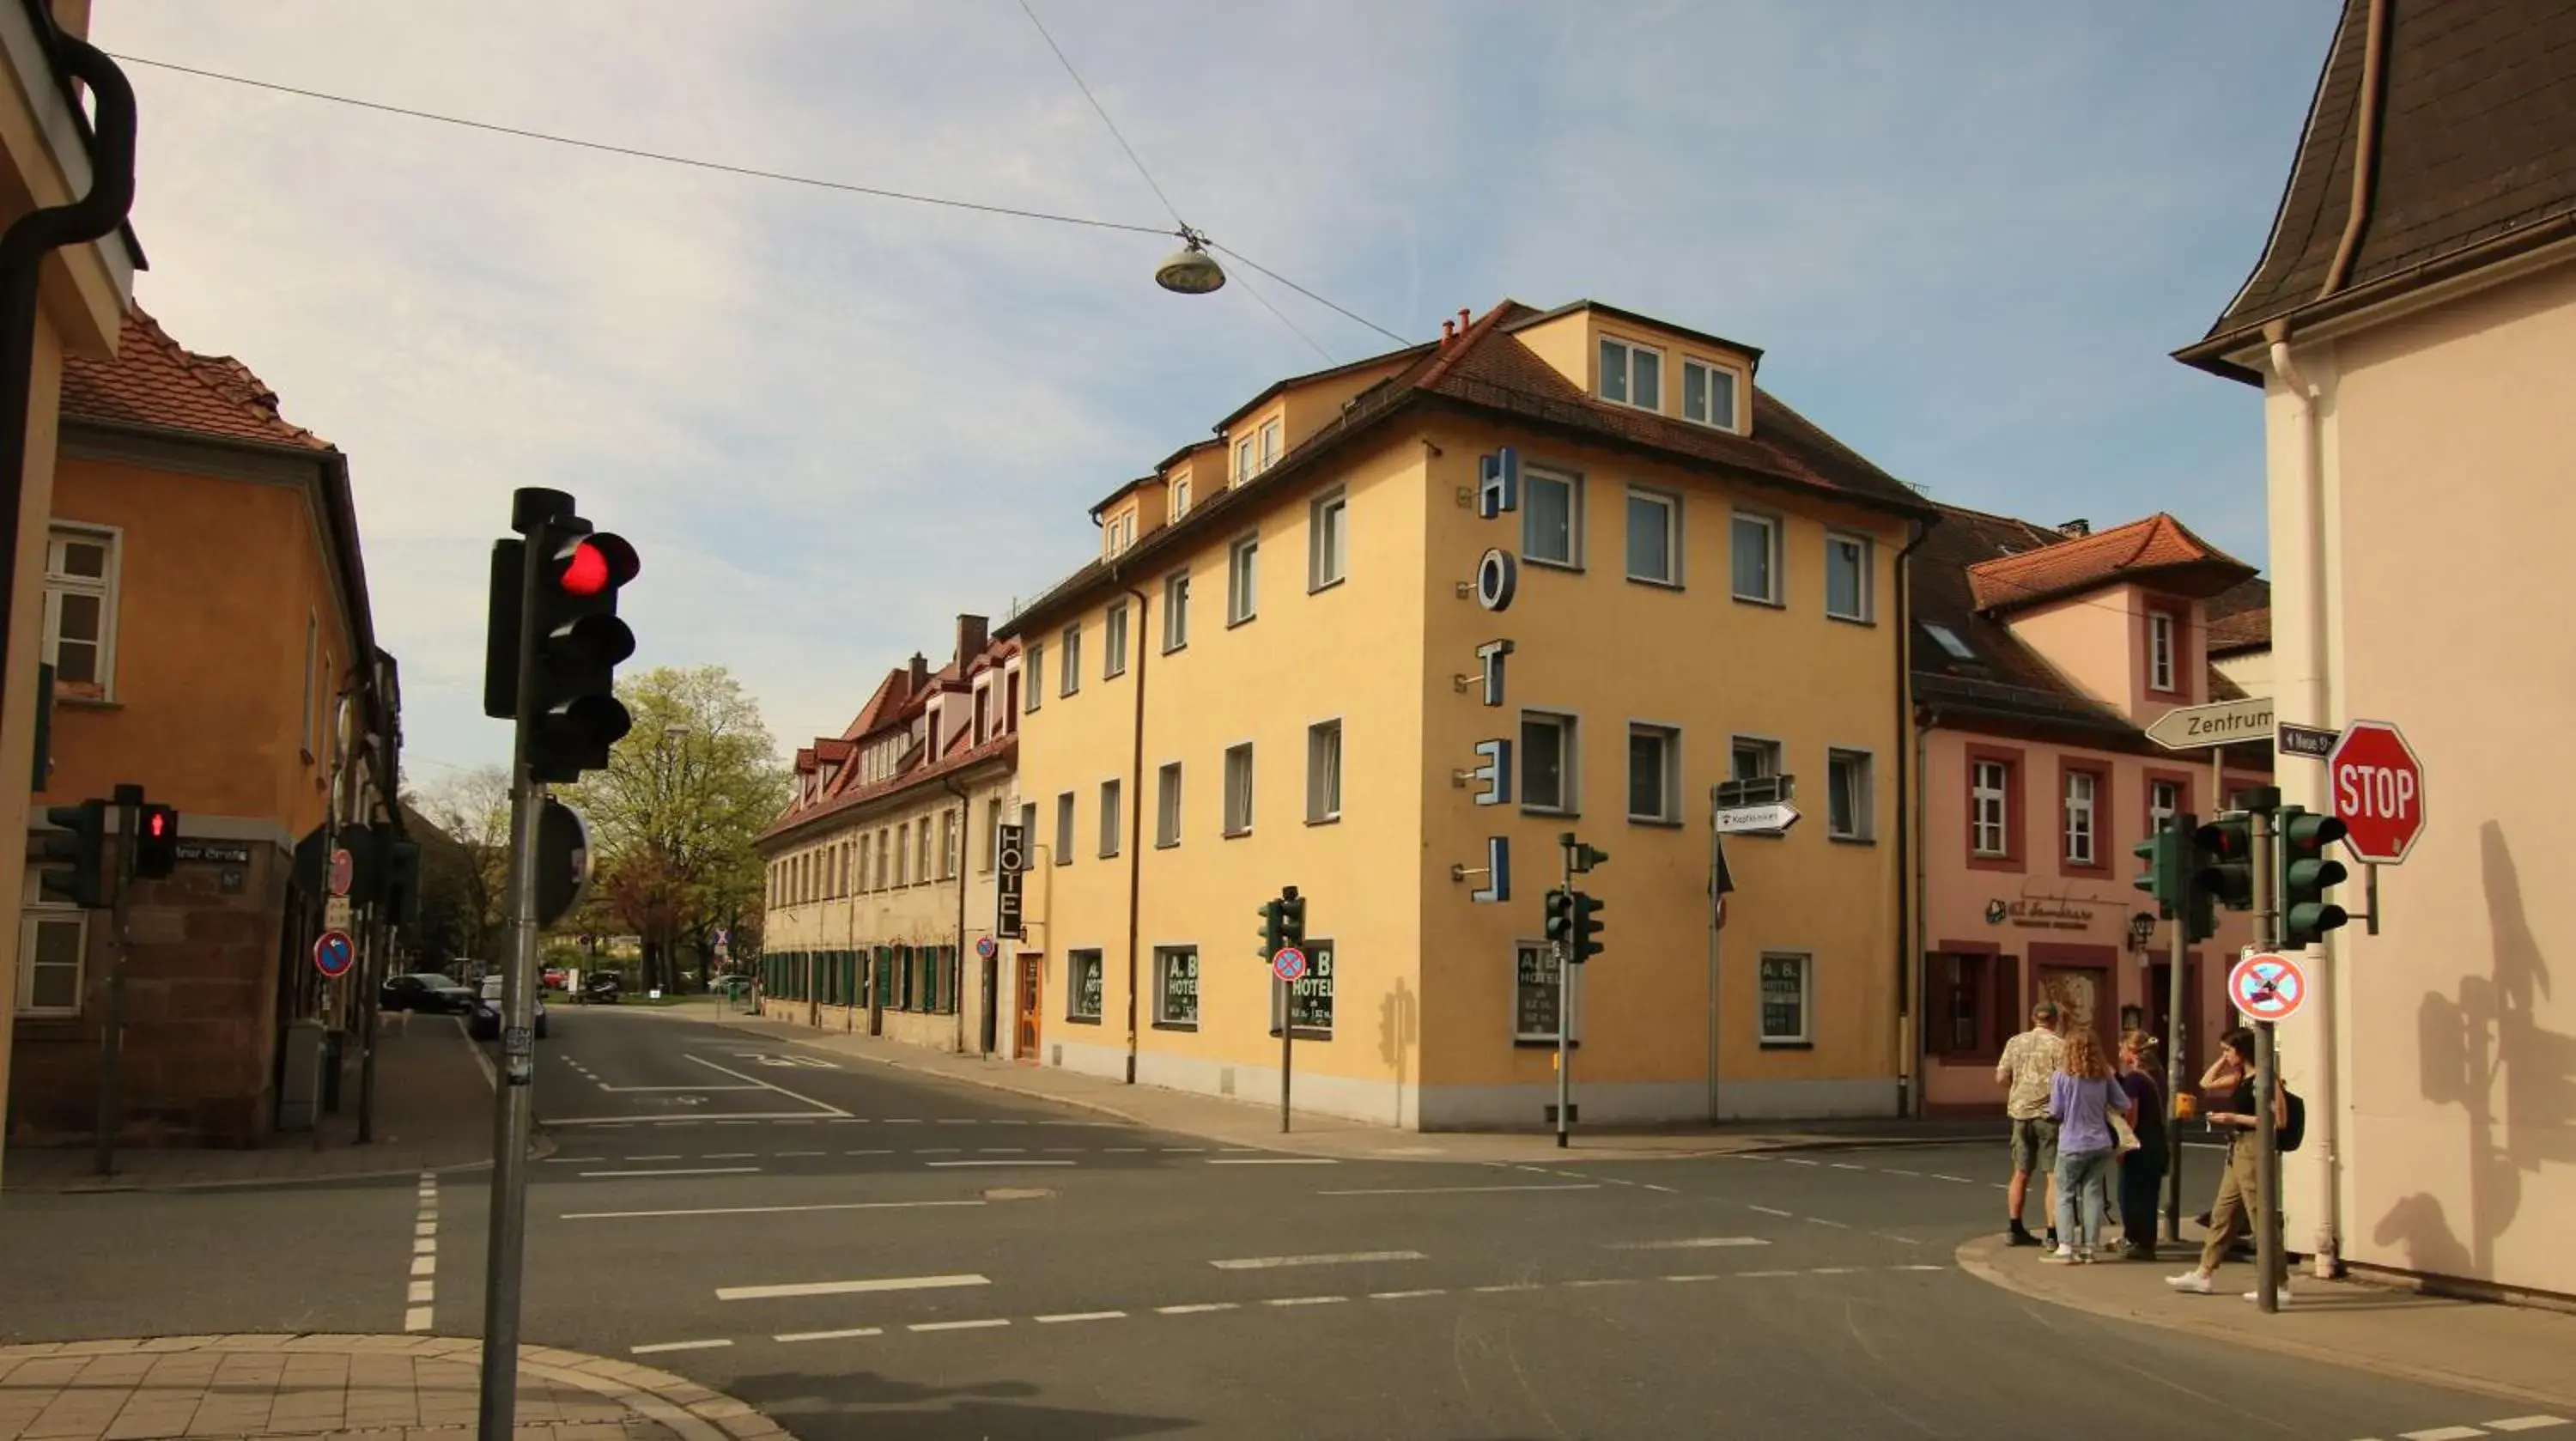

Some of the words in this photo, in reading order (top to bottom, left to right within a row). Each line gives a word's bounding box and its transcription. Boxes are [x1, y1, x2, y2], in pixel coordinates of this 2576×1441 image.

[2187, 711, 2274, 736] Zentrum
[2340, 763, 2415, 819] STOP
[999, 828, 1022, 936] HOTEL
[1292, 979, 1334, 996] HOTEL
